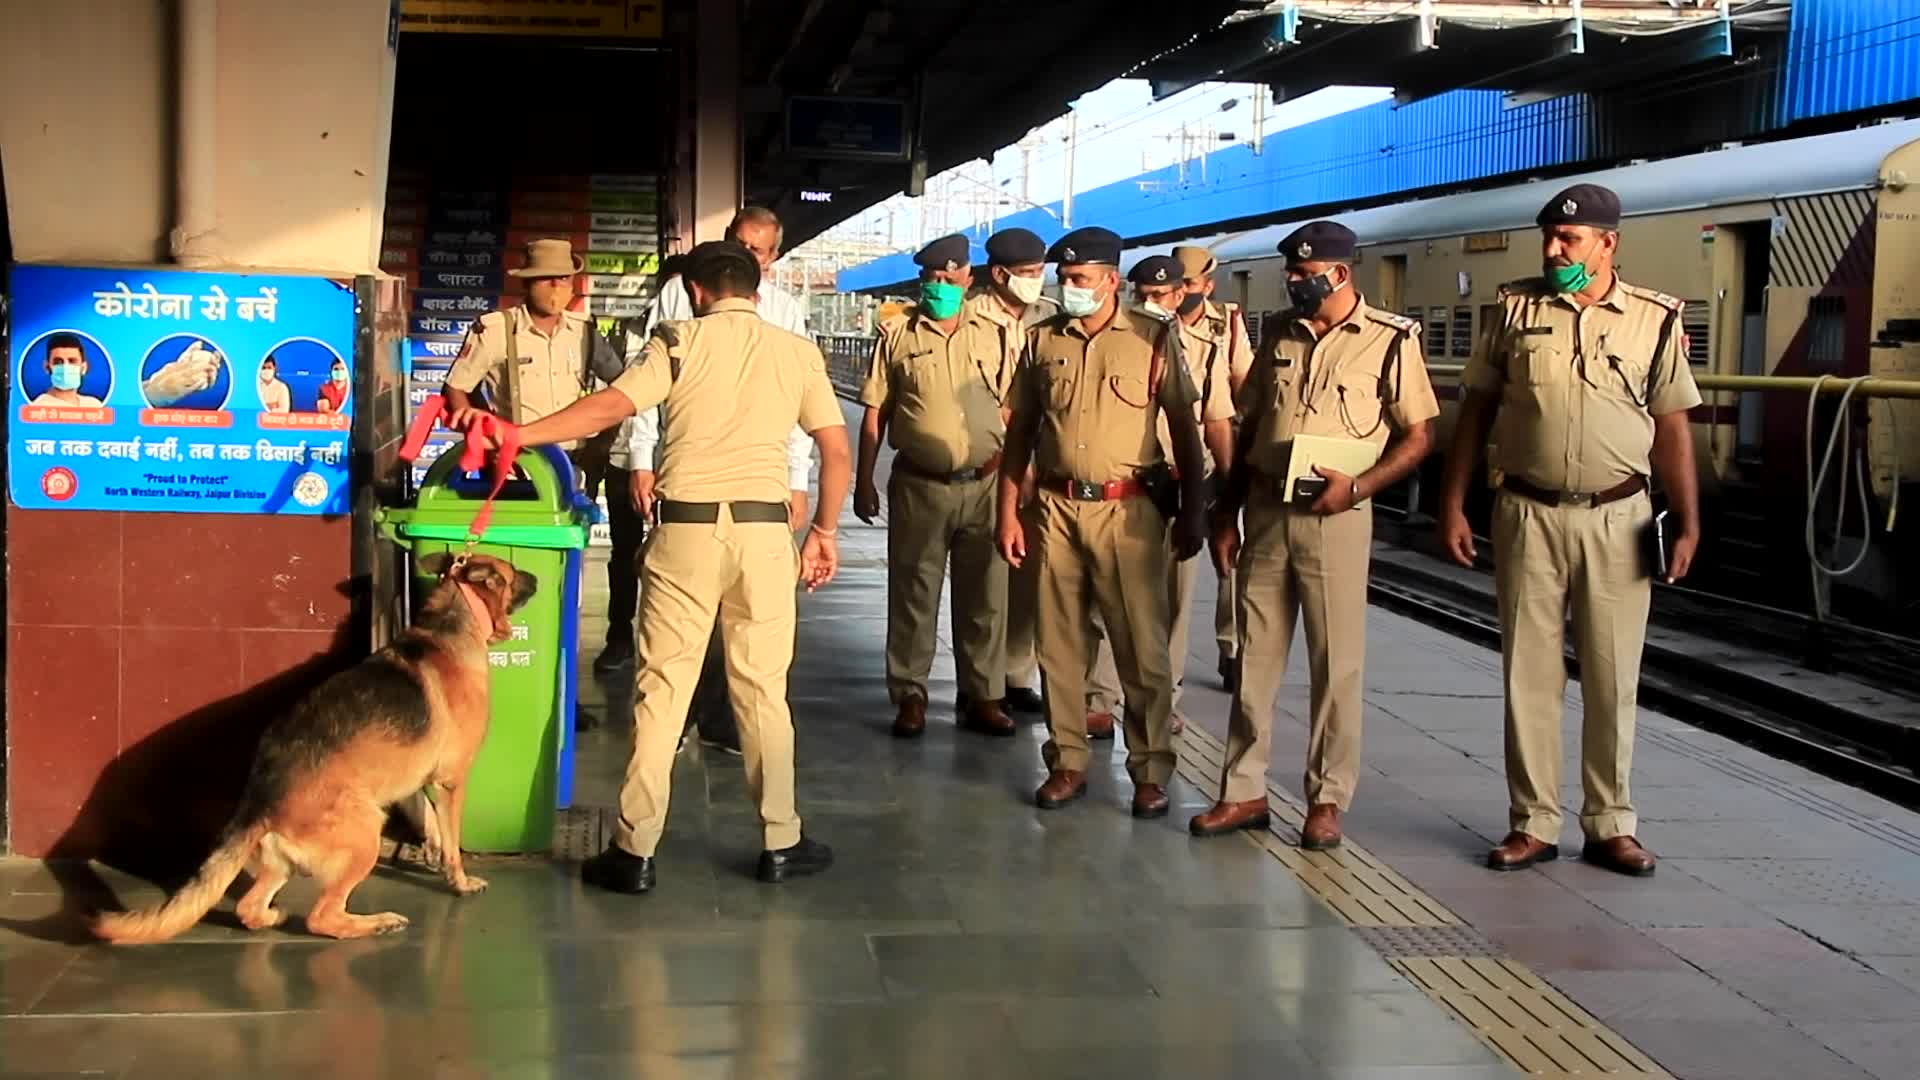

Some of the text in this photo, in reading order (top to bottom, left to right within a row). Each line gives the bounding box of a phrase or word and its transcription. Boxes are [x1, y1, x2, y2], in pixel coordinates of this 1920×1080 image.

[93, 281, 279, 323] कोरोना से बचें
[25, 439, 56, 456] जब
[59, 439, 93, 456] तक
[97, 435, 141, 461] दवाई
[188, 443, 215, 460] तब
[218, 444, 252, 461] तक
[255, 438, 307, 465] ढिलाई
[309, 440, 343, 465] नहीं
[178, 475, 187, 484] to
[104, 487, 128, 496] North
[131, 487, 165, 497] Western
[205, 489, 231, 500] Jaipur
[233, 489, 267, 499] Division
